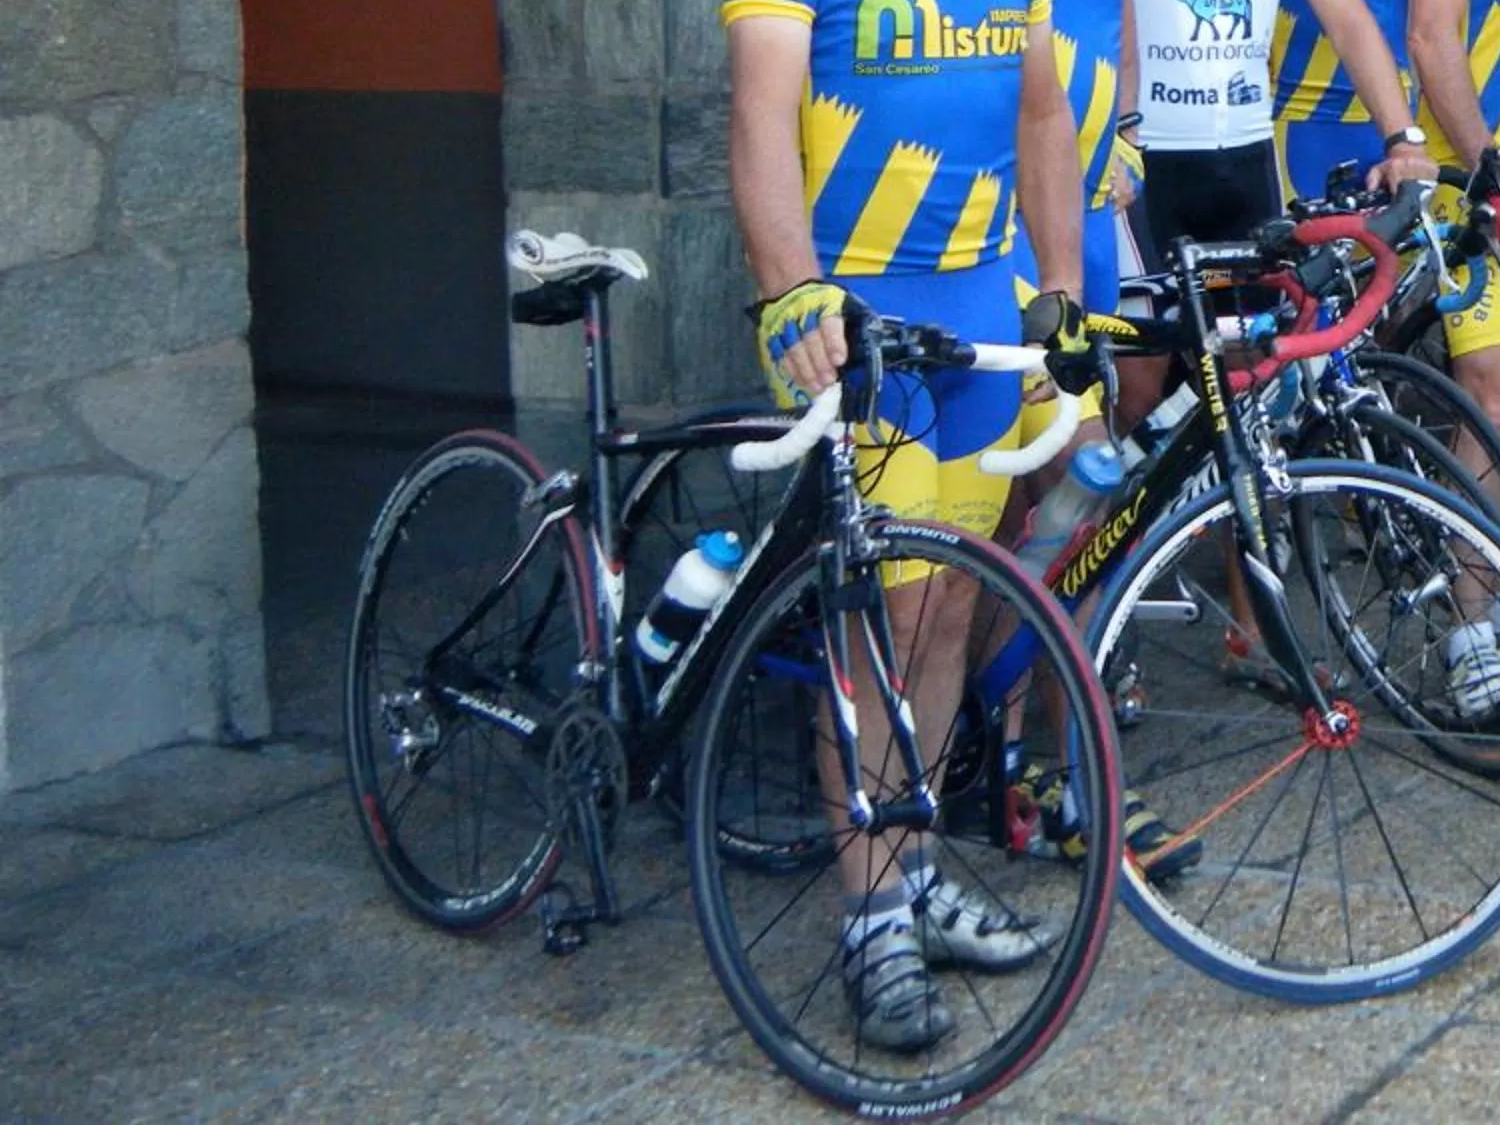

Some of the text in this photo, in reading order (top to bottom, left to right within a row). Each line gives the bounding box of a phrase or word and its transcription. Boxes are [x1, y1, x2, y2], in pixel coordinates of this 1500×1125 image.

[1147, 44, 1203, 62] novo
[1151, 81, 1219, 105] Roma
[1200, 353, 1228, 433] WILIER
[883, 524, 960, 544] DURANO
